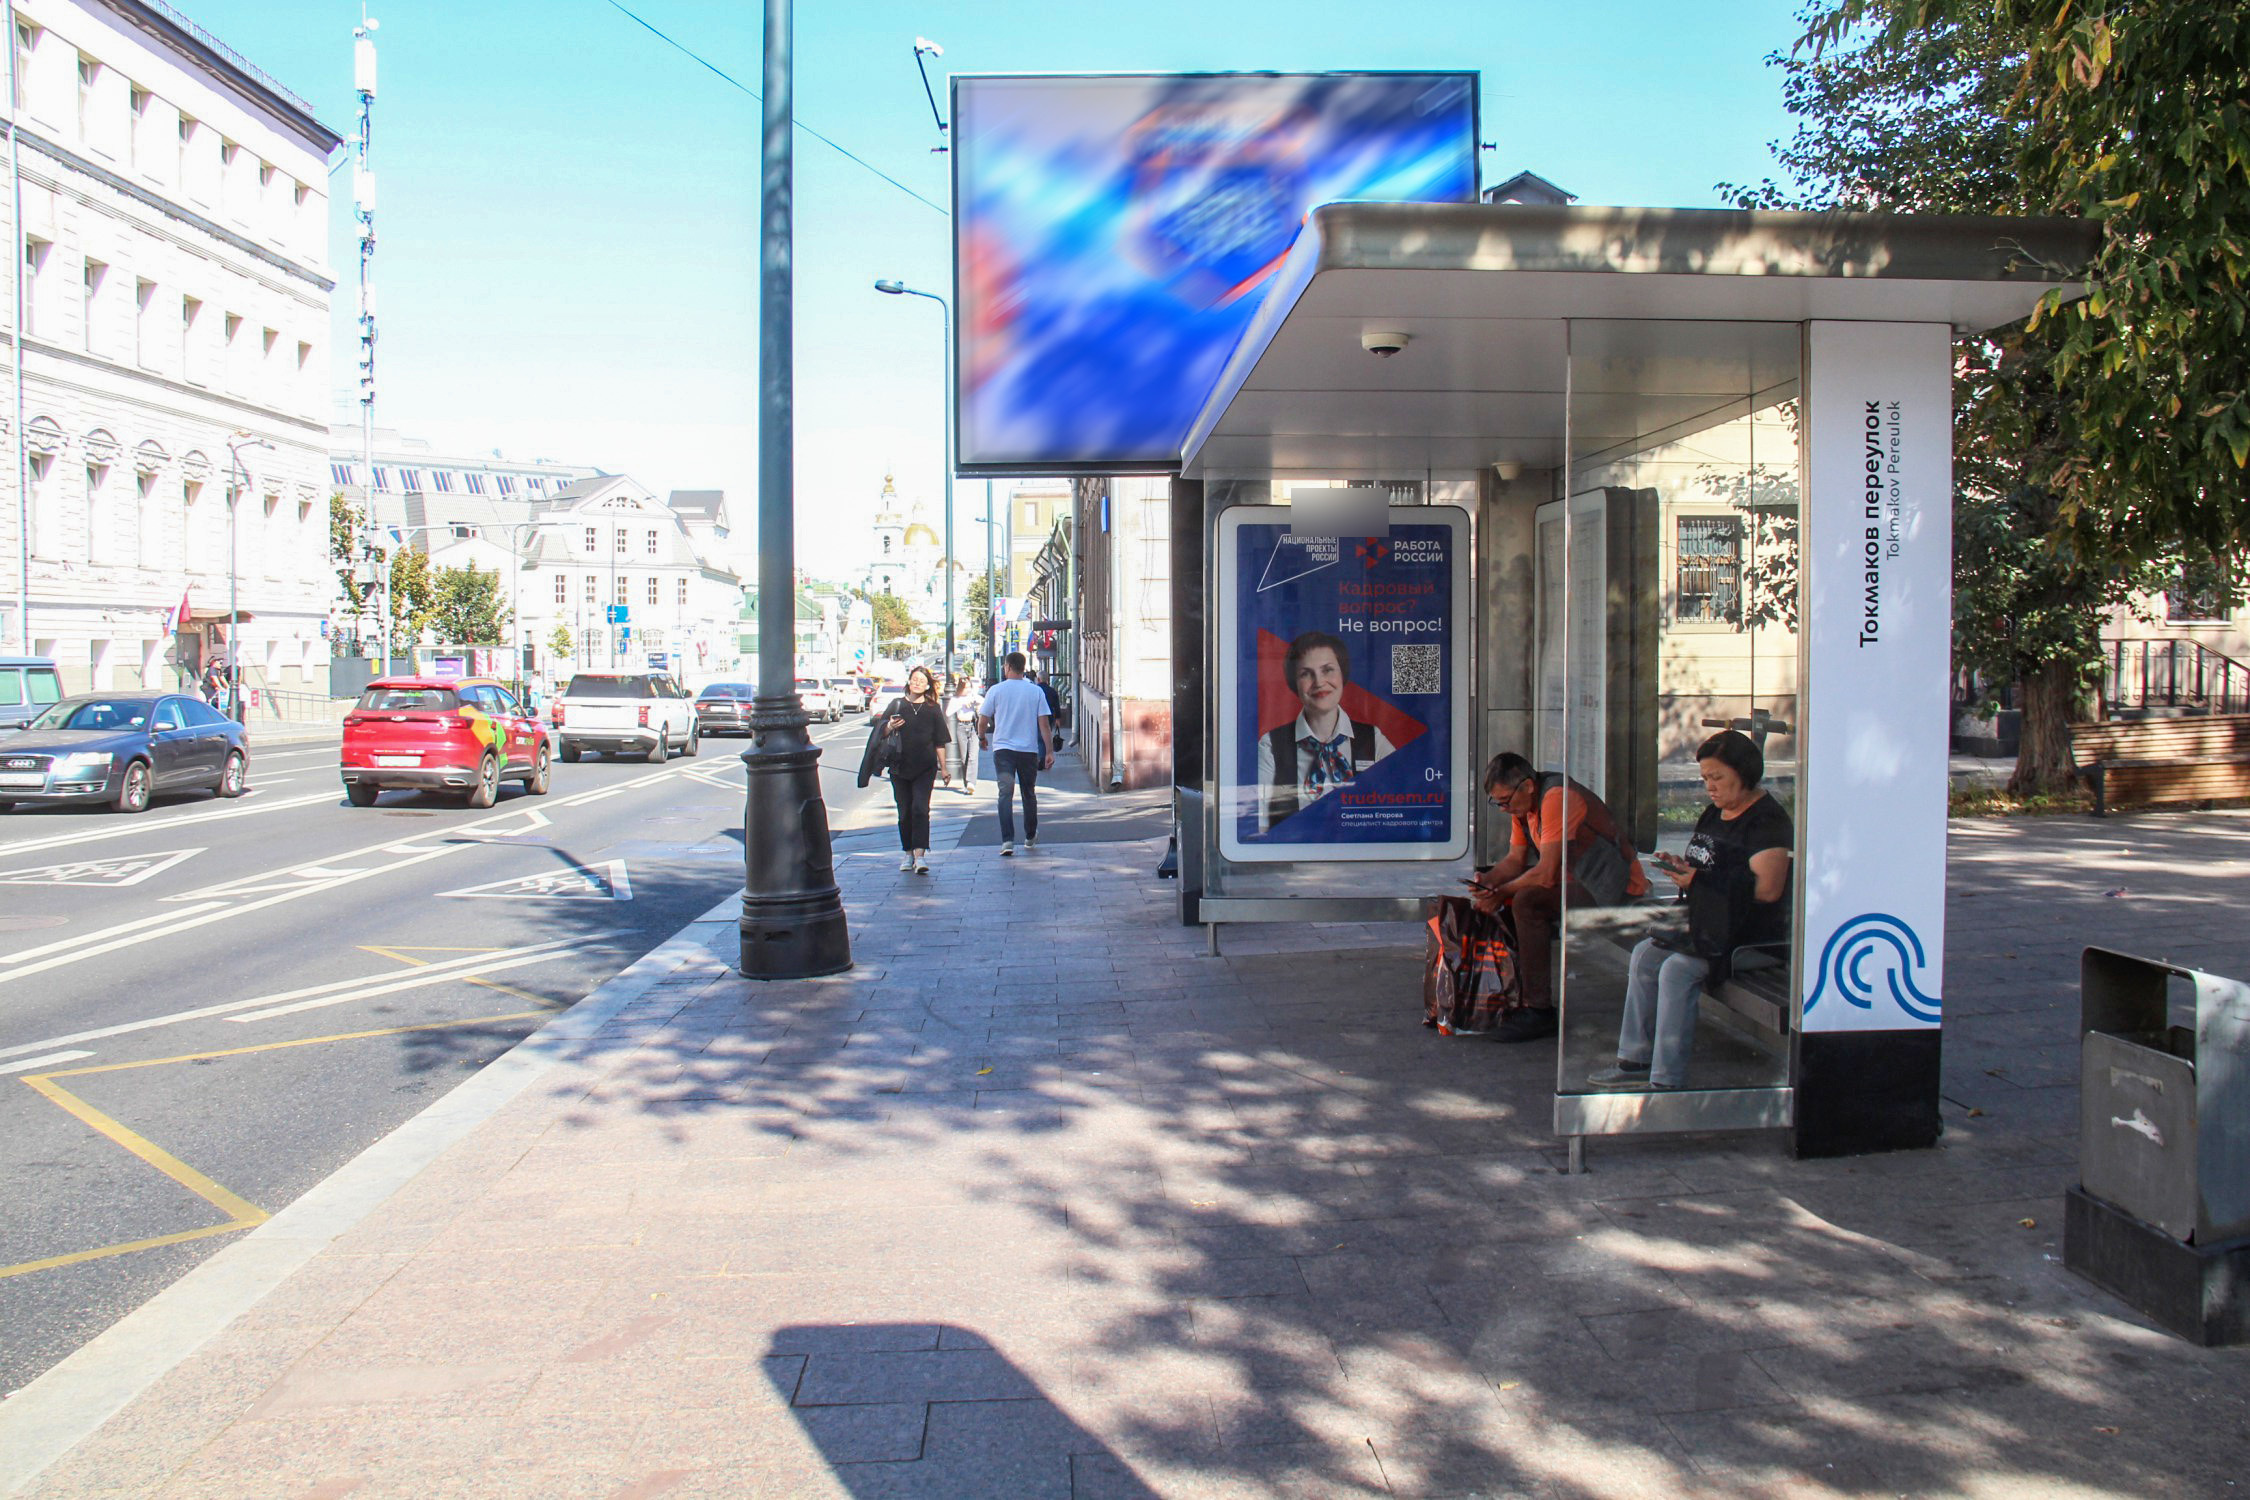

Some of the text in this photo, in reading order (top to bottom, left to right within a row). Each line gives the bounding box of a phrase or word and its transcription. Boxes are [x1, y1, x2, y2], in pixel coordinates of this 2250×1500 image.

[1886, 400, 1900, 560] Tokmakov Pereulok
[1860, 400, 1884, 648] Токмаков переулок
[1282, 536, 1337, 545] НАЦИОНАЛЬНЫЕ
[1394, 540, 1441, 551] РАБОТА
[1305, 544, 1337, 553] ПРОЕКТЫ
[1311, 552, 1337, 562] РОССИИ
[1394, 552, 1443, 562] РОССИИ
[1339, 580, 1435, 597] Кадровый
[1339, 598, 1418, 616] вопрос?
[1339, 617, 1442, 635] Не вопрос!
[1425, 767, 1443, 782] 0+
[1341, 790, 1444, 805] trudvsem.ru
[1341, 812, 1403, 821] Светлана Егорова
[1341, 820, 1381, 828] специалист
[1382, 820, 1418, 828] кадрового
